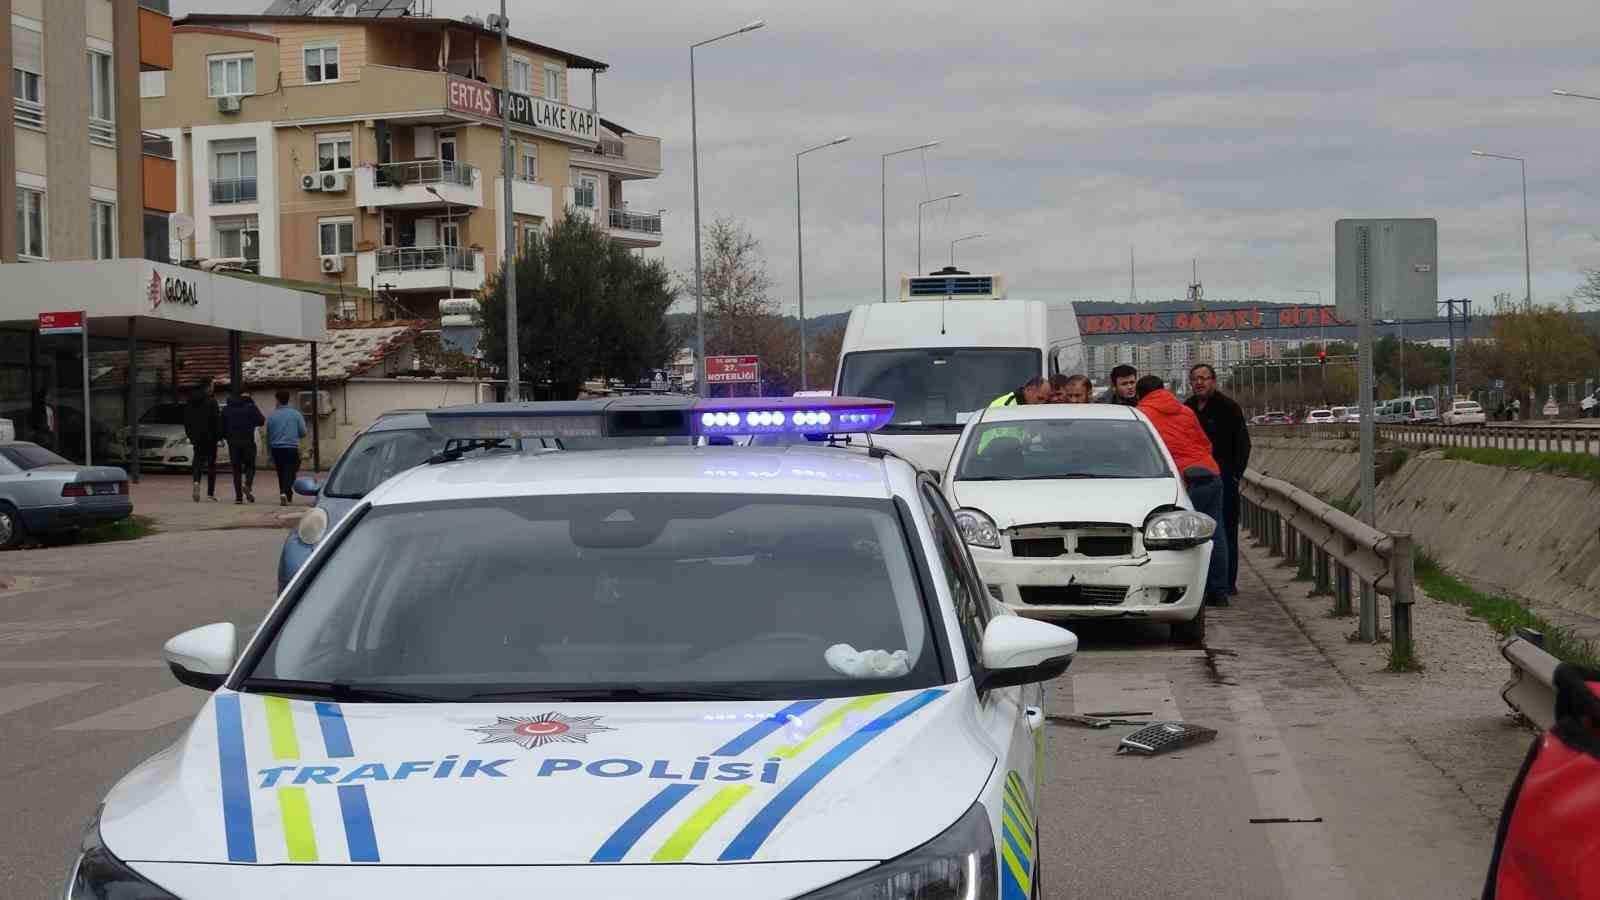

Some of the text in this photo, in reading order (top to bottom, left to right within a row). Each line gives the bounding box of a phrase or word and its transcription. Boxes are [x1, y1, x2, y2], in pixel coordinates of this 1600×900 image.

[450, 82, 492, 114] ERTAŞ
[536, 101, 566, 129] LAKE
[570, 111, 598, 137] KAPI
[165, 277, 198, 305] GLOBAL
[257, 755, 781, 788] TRAFİK POLİSİ
